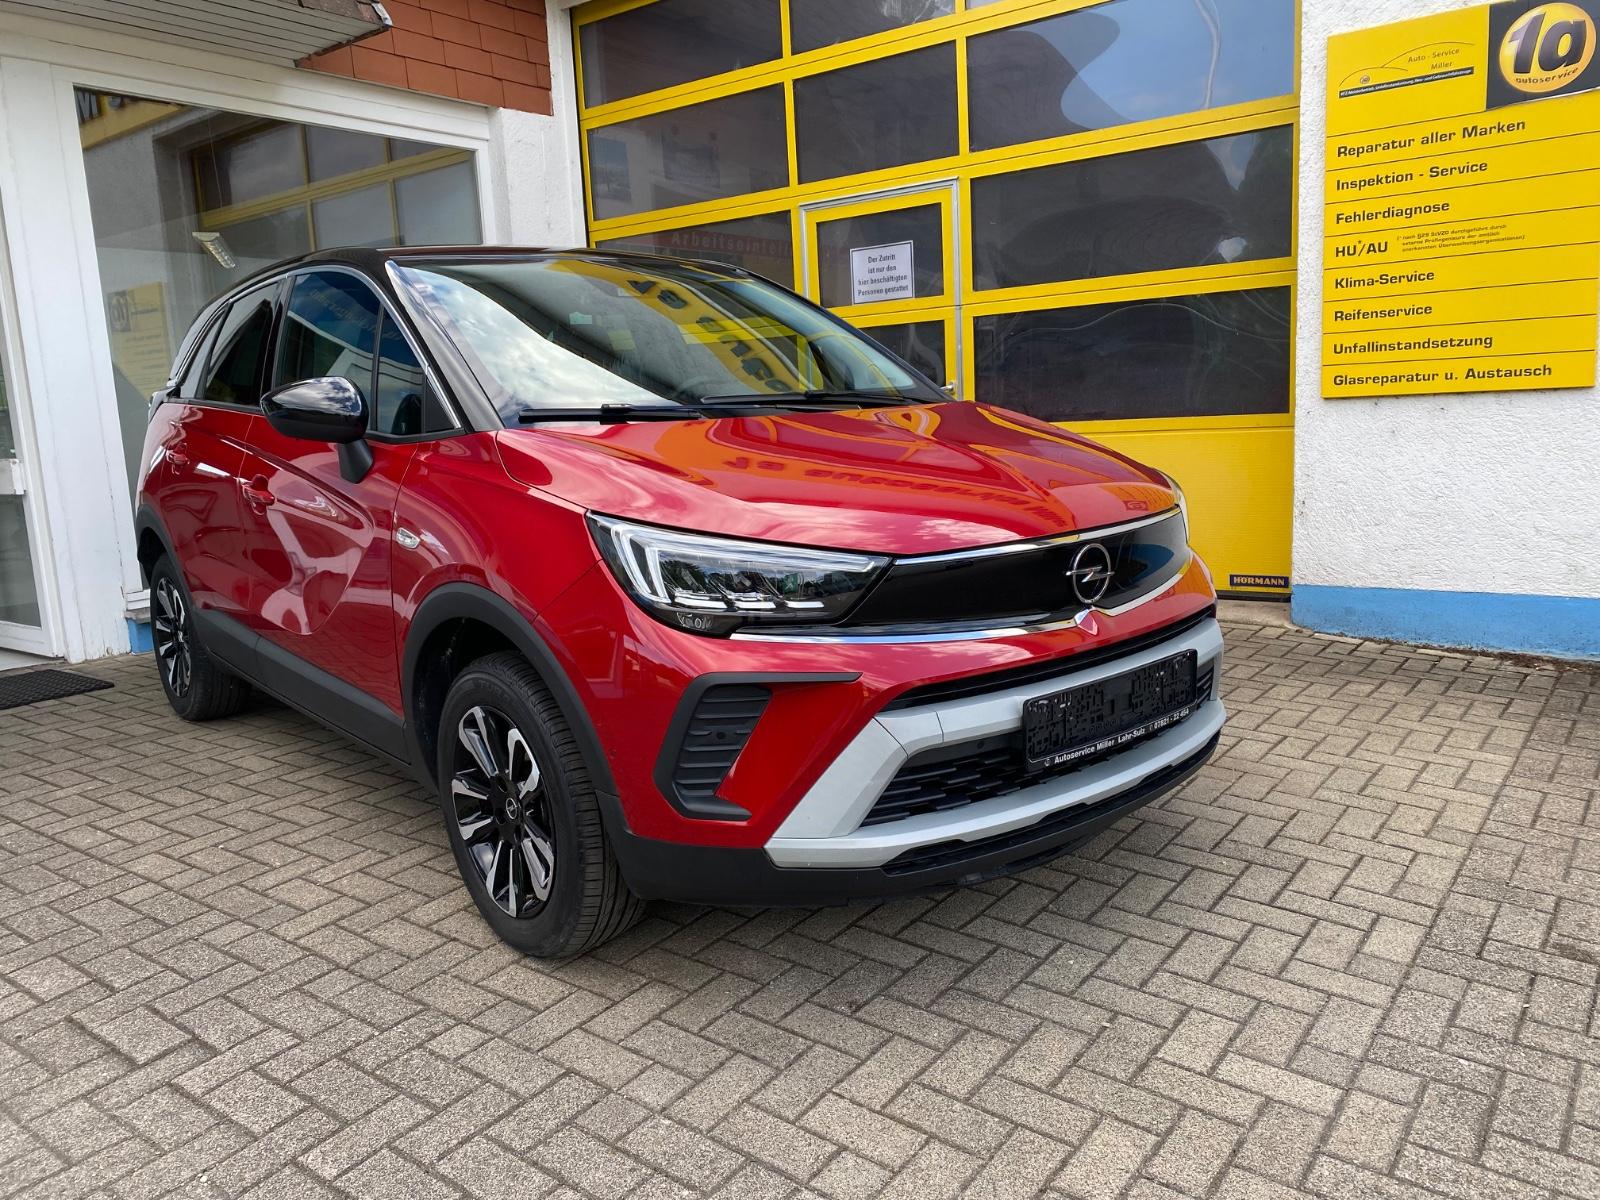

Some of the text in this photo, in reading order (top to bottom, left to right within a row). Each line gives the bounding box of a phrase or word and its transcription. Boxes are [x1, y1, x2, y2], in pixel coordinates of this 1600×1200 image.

[1508, 12, 1587, 74] 1a
[1408, 55, 1426, 63] Auto
[1432, 48, 1460, 59] Service
[1431, 61, 1453, 70] Miller
[1516, 67, 1579, 84] autoservice
[1337, 119, 1526, 158] Reparatur aller Marken
[1336, 171, 1414, 192] Inspektion
[1429, 161, 1489, 179] Service
[1335, 201, 1450, 226] Fehlerdiagnose
[878, 254, 896, 262] Zutritt
[858, 274, 908, 286] hier beschäftigten
[867, 266, 875, 274] ist
[1334, 269, 1435, 290] Klima-Service
[857, 284, 909, 296] Personen gestattet
[1334, 304, 1433, 323] Reifenservice
[1333, 335, 1494, 356] Unfallinstandsetzung
[1333, 364, 1552, 387] Glasreparatur u. Austausch
[1054, 745, 1095, 764] Autoservice
[1096, 739, 1115, 751] Miller
[1117, 727, 1146, 743] Lahr-Sulz
